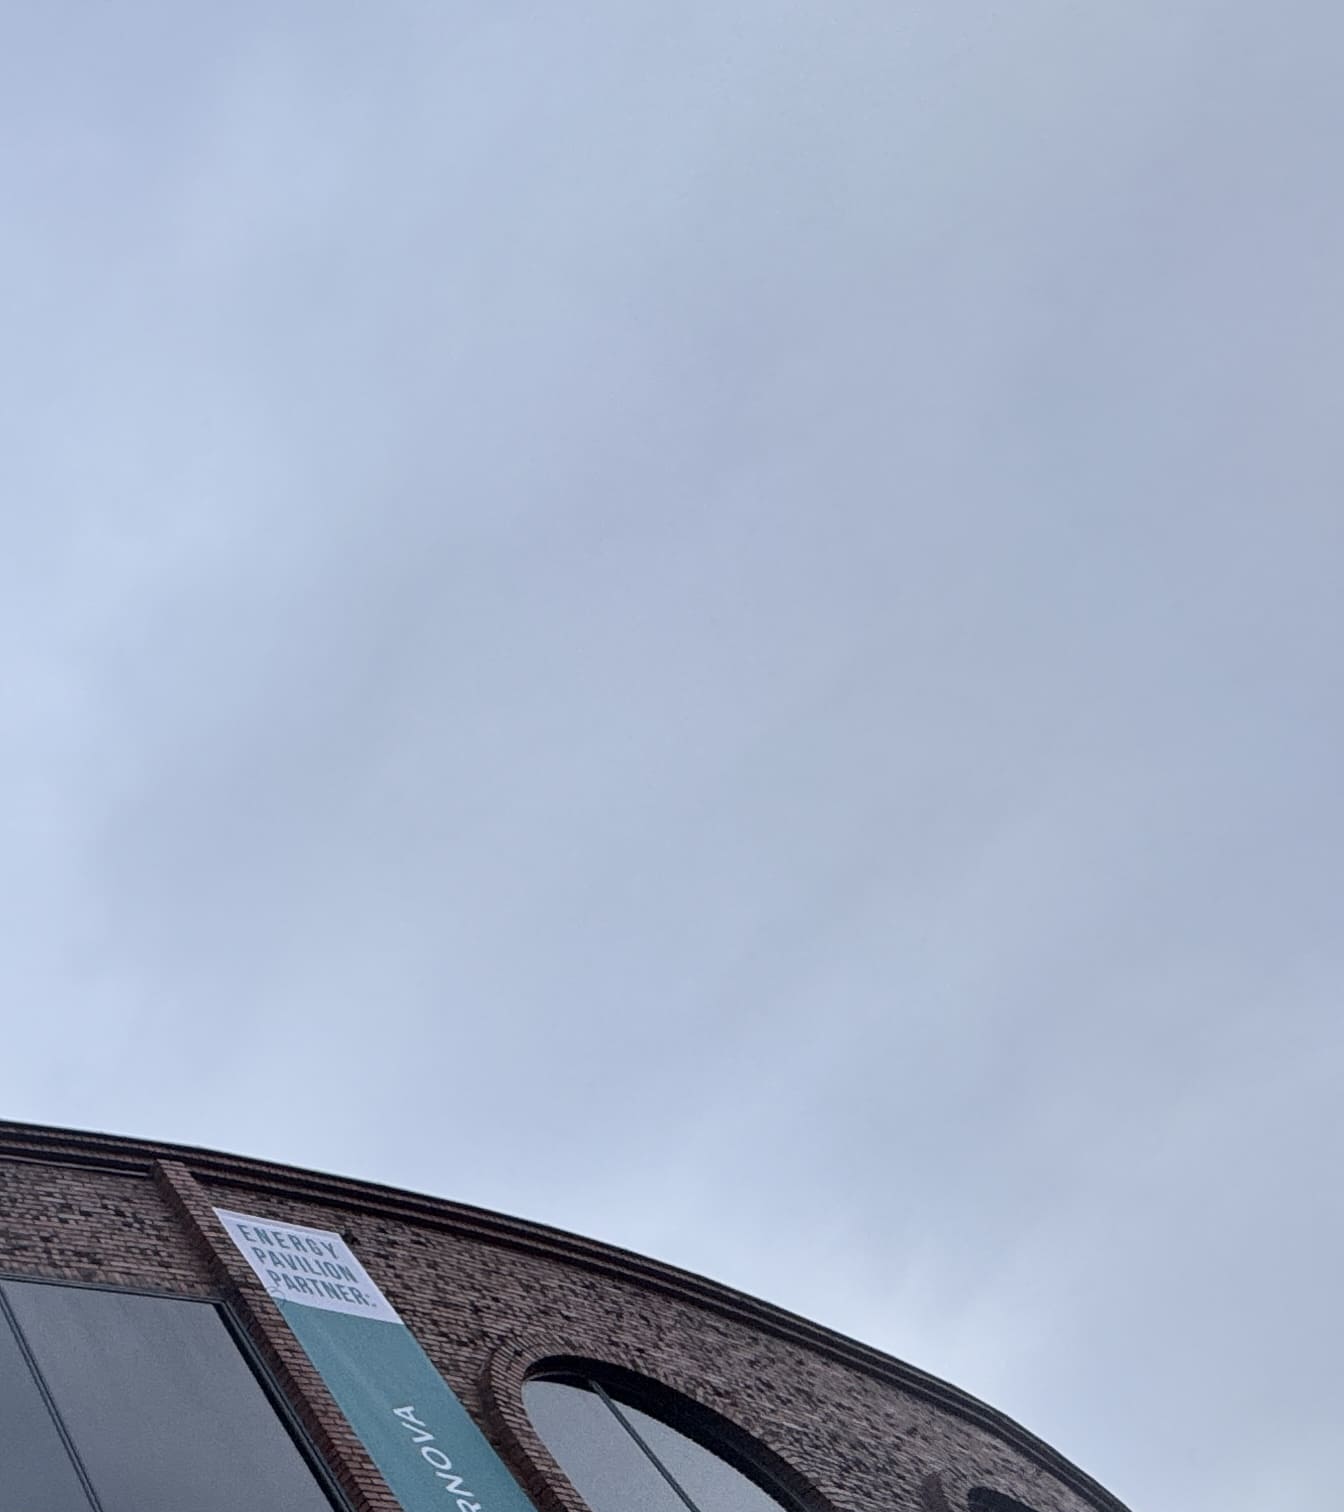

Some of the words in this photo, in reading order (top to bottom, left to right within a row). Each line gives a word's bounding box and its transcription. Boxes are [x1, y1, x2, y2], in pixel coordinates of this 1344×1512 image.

[236, 1223, 339, 1260] ENERGY
[250, 1246, 360, 1284] PAVILION
[265, 1269, 377, 1307] PARTNER:
